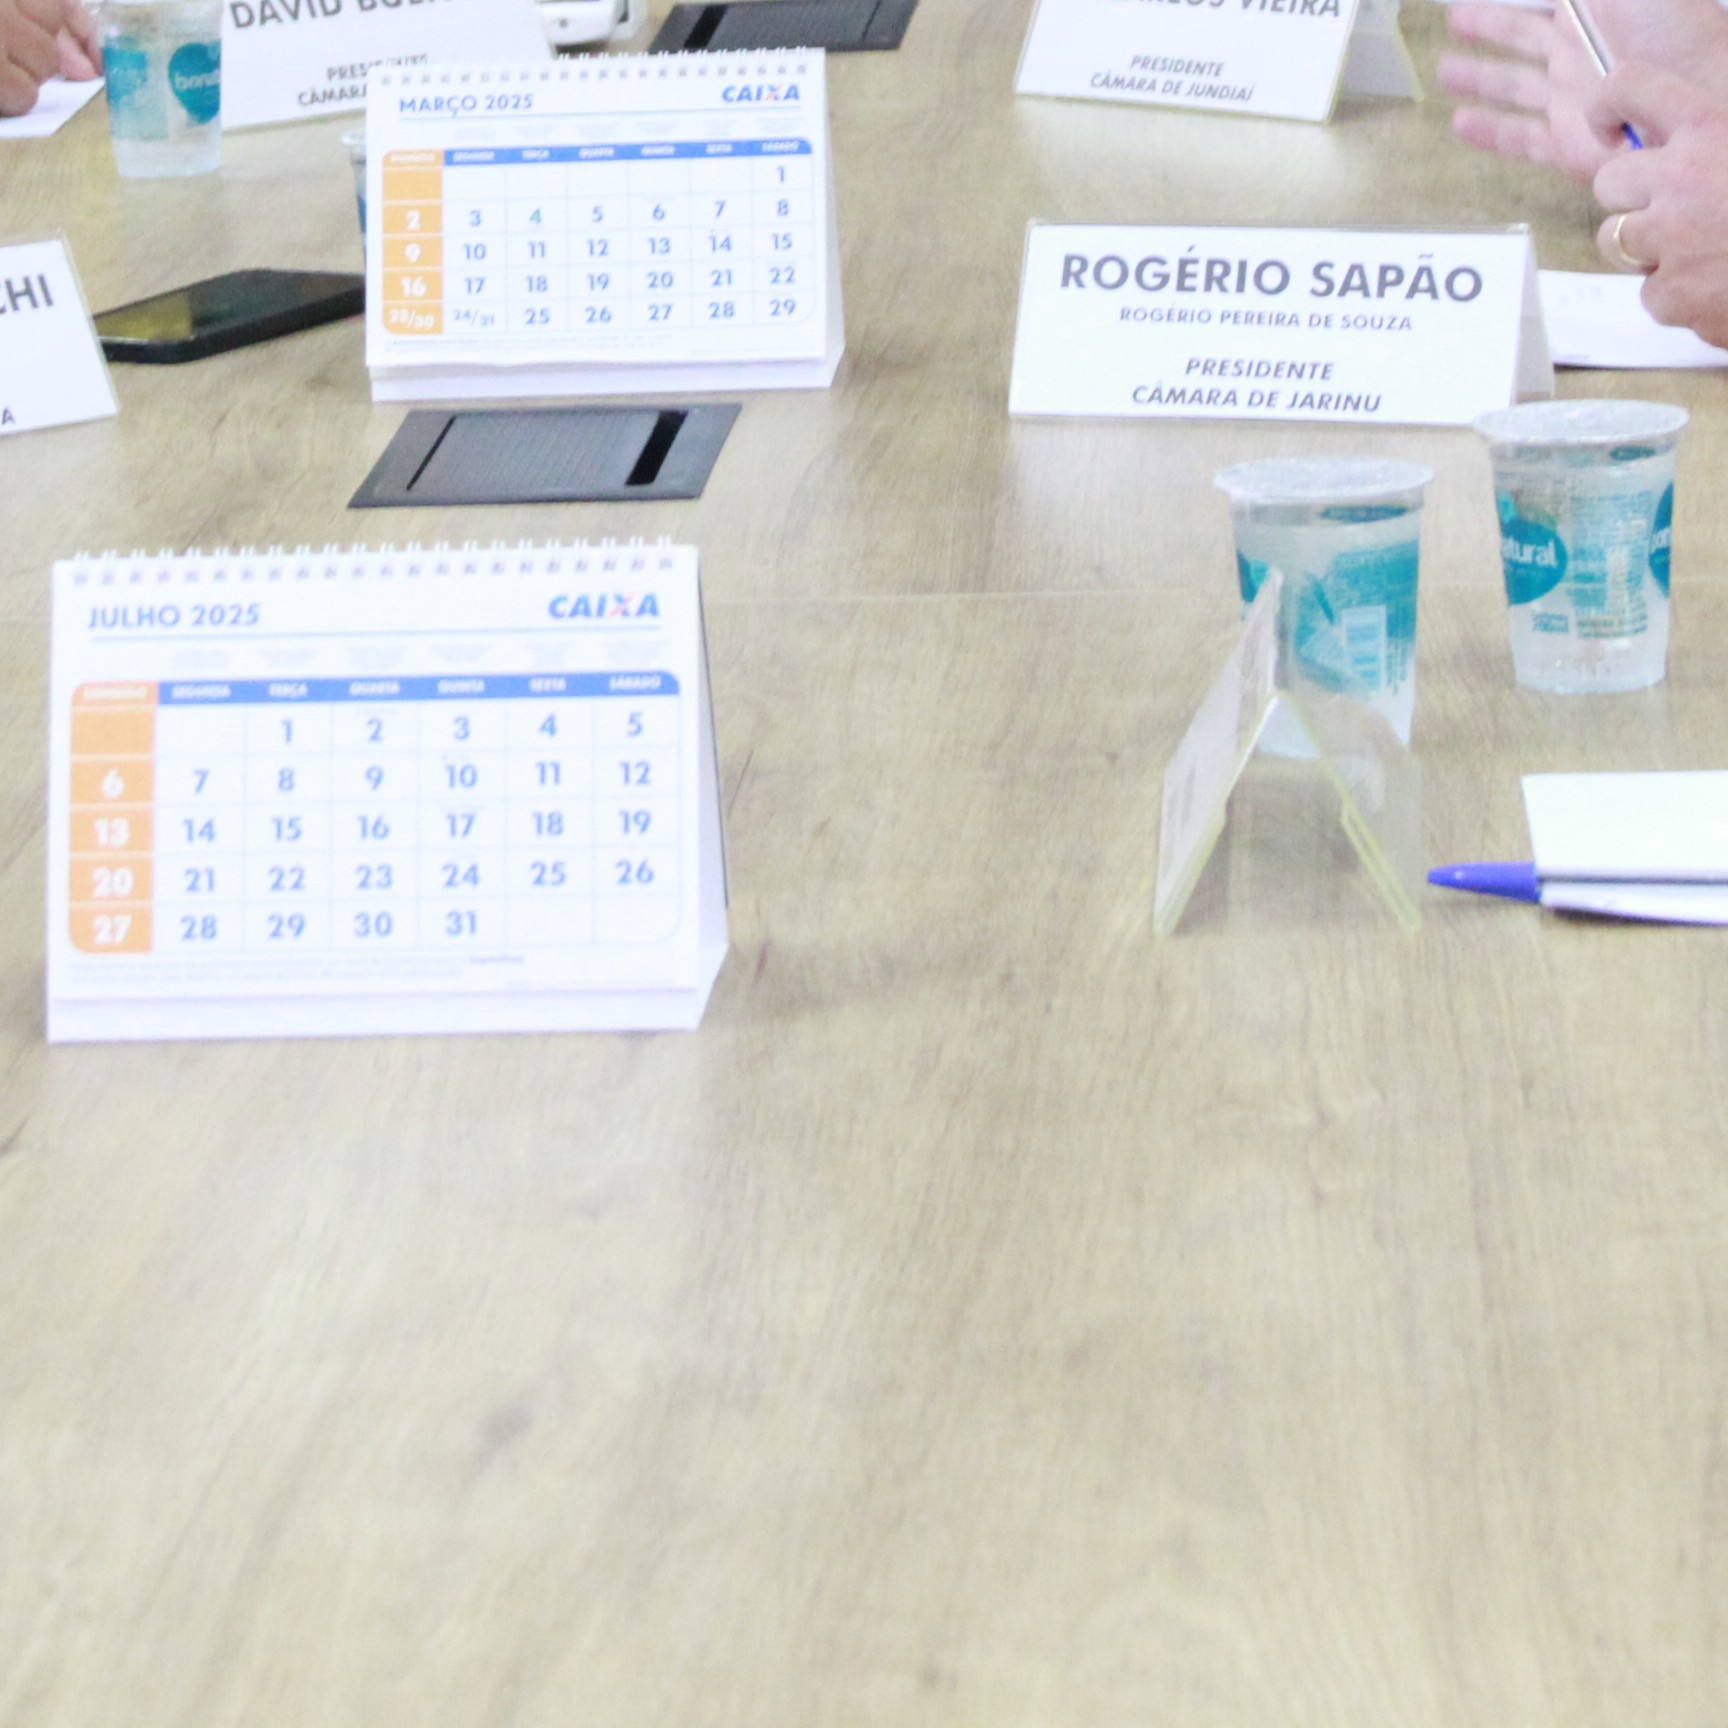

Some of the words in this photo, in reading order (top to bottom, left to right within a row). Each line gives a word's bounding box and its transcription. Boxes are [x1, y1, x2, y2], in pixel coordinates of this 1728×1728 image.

[1130, 54, 1225, 78] PRESIDENTE
[721, 83, 801, 104] CAIXA
[1090, 70, 1158, 94] CÂMARA
[1161, 78, 1183, 96] DE
[1185, 82, 1256, 102] JUNDIAÍ
[399, 94, 478, 118] MARÇO
[485, 93, 534, 112] 2025
[775, 164, 788, 185] 1
[404, 208, 423, 233] 2
[468, 208, 484, 229] 3
[527, 206, 544, 226] 4
[590, 204, 606, 225] 5
[651, 202, 668, 223] 6
[713, 198, 728, 219] 7
[775, 197, 791, 218] 8
[403, 241, 423, 264] 9
[462, 241, 488, 262] 10
[526, 240, 548, 260] 11
[586, 237, 610, 258] 12
[646, 235, 672, 257] 13
[707, 233, 734, 254] 14
[770, 231, 794, 252] 15
[399, 275, 429, 299] 16
[463, 275, 487, 296] 17
[524, 274, 550, 294] 18
[586, 271, 612, 292] 19
[646, 270, 675, 291] 20
[709, 267, 734, 289] 21
[768, 264, 796, 286] 22
[1060, 244, 1291, 297] ROGÉRIO
[1308, 253, 1484, 303] SAPÃO
[524, 306, 552, 327] 25
[584, 305, 614, 325] 26
[647, 302, 674, 323] 27
[707, 299, 737, 321] 28
[768, 297, 798, 318] 29
[1120, 303, 1213, 325] ROGÉRIO
[1219, 310, 1301, 329] PEREIRA
[1308, 313, 1334, 330] DE
[1339, 313, 1413, 332] SOUZA
[1185, 357, 1335, 382] PRESIDENTE
[1132, 381, 1238, 408] CÂMARA
[1247, 389, 1281, 410] DE
[1285, 391, 1382, 413] JARINU
[89, 604, 180, 630] JULHO
[191, 603, 260, 627] 2025
[548, 593, 660, 621] CAIXA
[280, 717, 295, 746] 1
[365, 716, 385, 746] 2
[452, 714, 472, 743] 3
[537, 712, 559, 739] 4
[626, 710, 645, 740] 5
[99, 768, 127, 802] 6
[192, 767, 212, 797] 7
[276, 766, 297, 794] 8
[363, 764, 386, 792] 9
[444, 762, 480, 790] 10
[534, 760, 562, 787] 11
[618, 759, 652, 787] 12
[92, 815, 131, 850] 13
[181, 817, 218, 845] 14
[271, 815, 304, 843] 15
[356, 814, 392, 842] 16
[445, 811, 478, 840] 17
[531, 810, 566, 838] 18
[618, 809, 653, 836] 19
[91, 865, 136, 901] 20
[183, 866, 217, 895] 21
[267, 864, 306, 894] 22
[354, 862, 395, 892] 23
[441, 862, 482, 890] 24
[529, 860, 568, 889] 25
[614, 858, 656, 887] 26
[91, 912, 134, 947] 27
[179, 913, 219, 942] 28
[266, 912, 308, 941] 29
[353, 910, 395, 940] 30
[444, 909, 479, 939] 31
